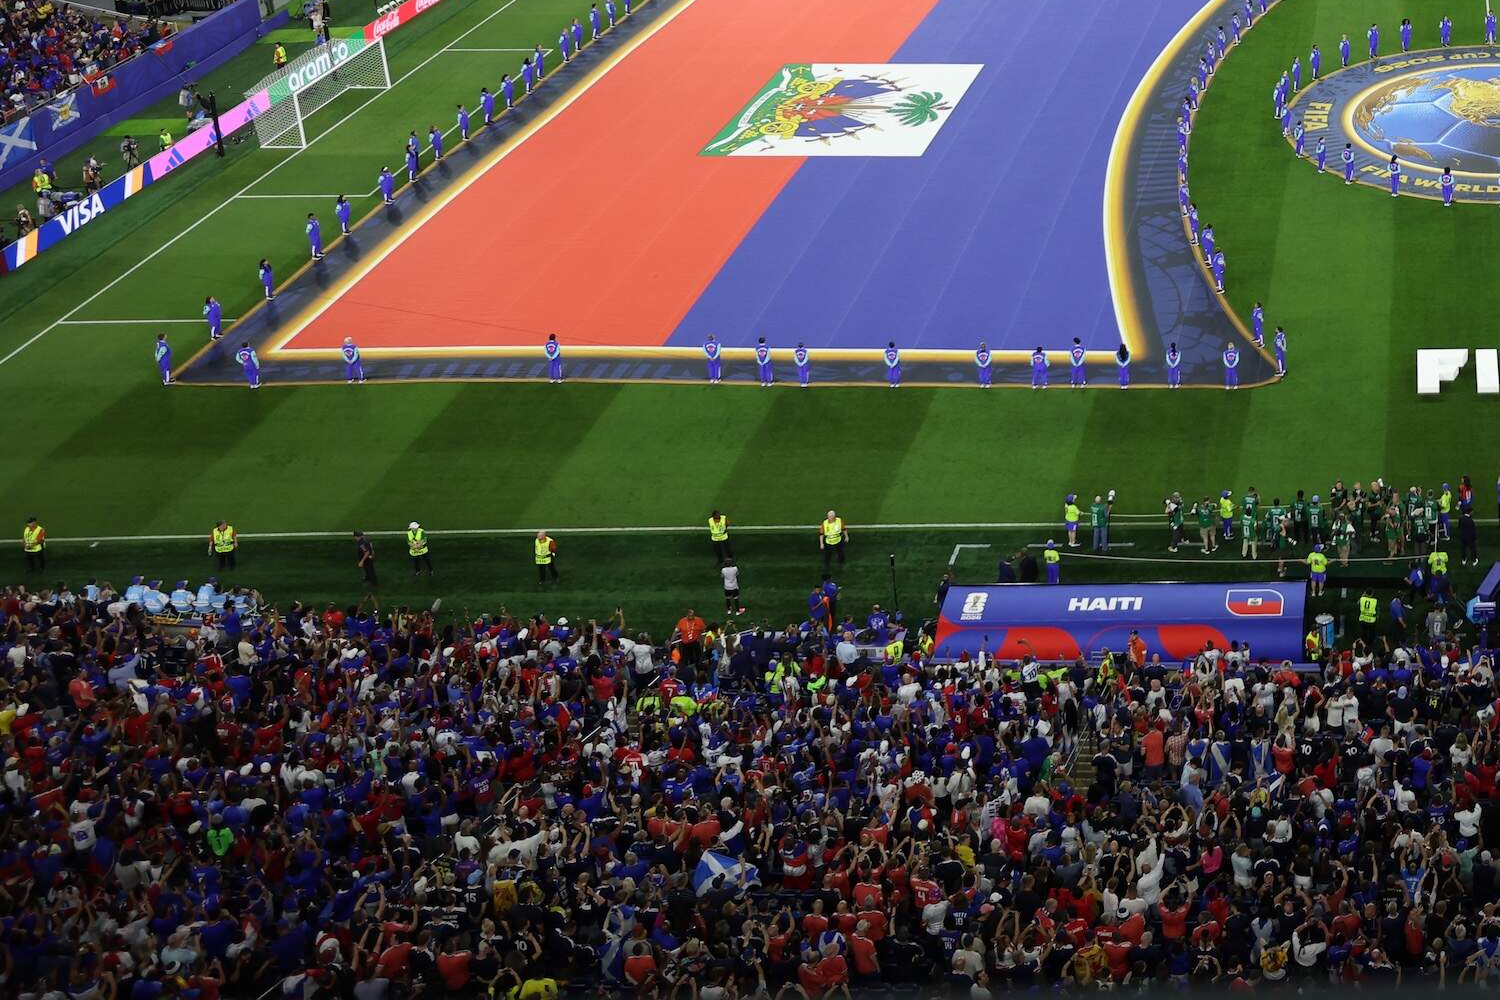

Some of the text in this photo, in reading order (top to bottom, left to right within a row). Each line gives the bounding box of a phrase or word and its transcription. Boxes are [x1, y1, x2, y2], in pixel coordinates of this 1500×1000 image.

[1304, 102, 1333, 132] FIFA
[56, 193, 106, 235] VISA
[1067, 596, 1143, 611] HAITI
[1300, 744, 1312, 755] 10
[1345, 747, 1357, 756] 10
